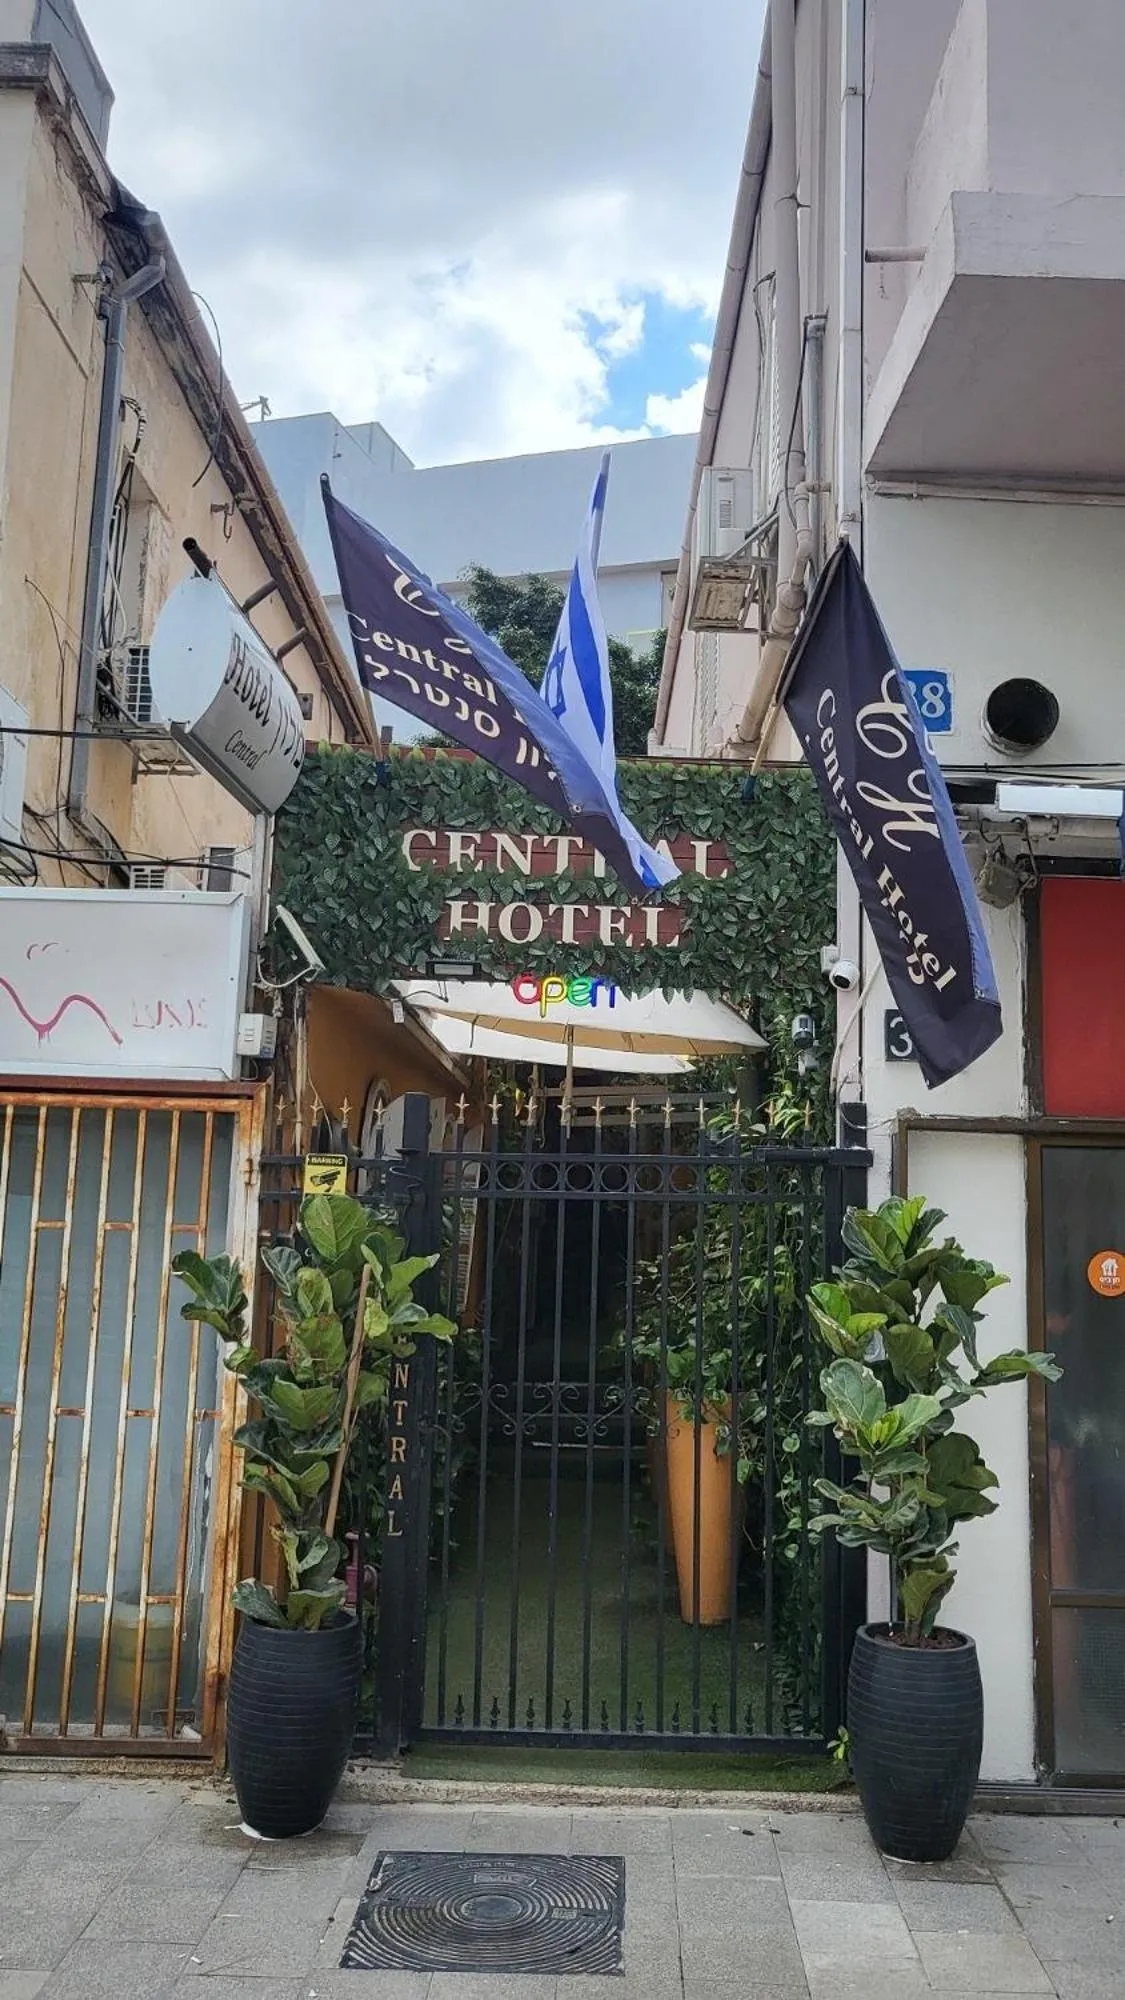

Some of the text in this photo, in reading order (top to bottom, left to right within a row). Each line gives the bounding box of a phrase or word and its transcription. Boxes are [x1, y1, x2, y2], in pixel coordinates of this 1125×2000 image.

[224, 632, 274, 727] Hotel
[347, 611, 499, 706] Central
[364, 655, 501, 738] סנטרל
[225, 729, 268, 770] Central
[816, 688, 874, 860] Central
[877, 864, 957, 992] Hotel
[444, 900, 680, 948] HOTEL
[512, 970, 616, 1018] open
